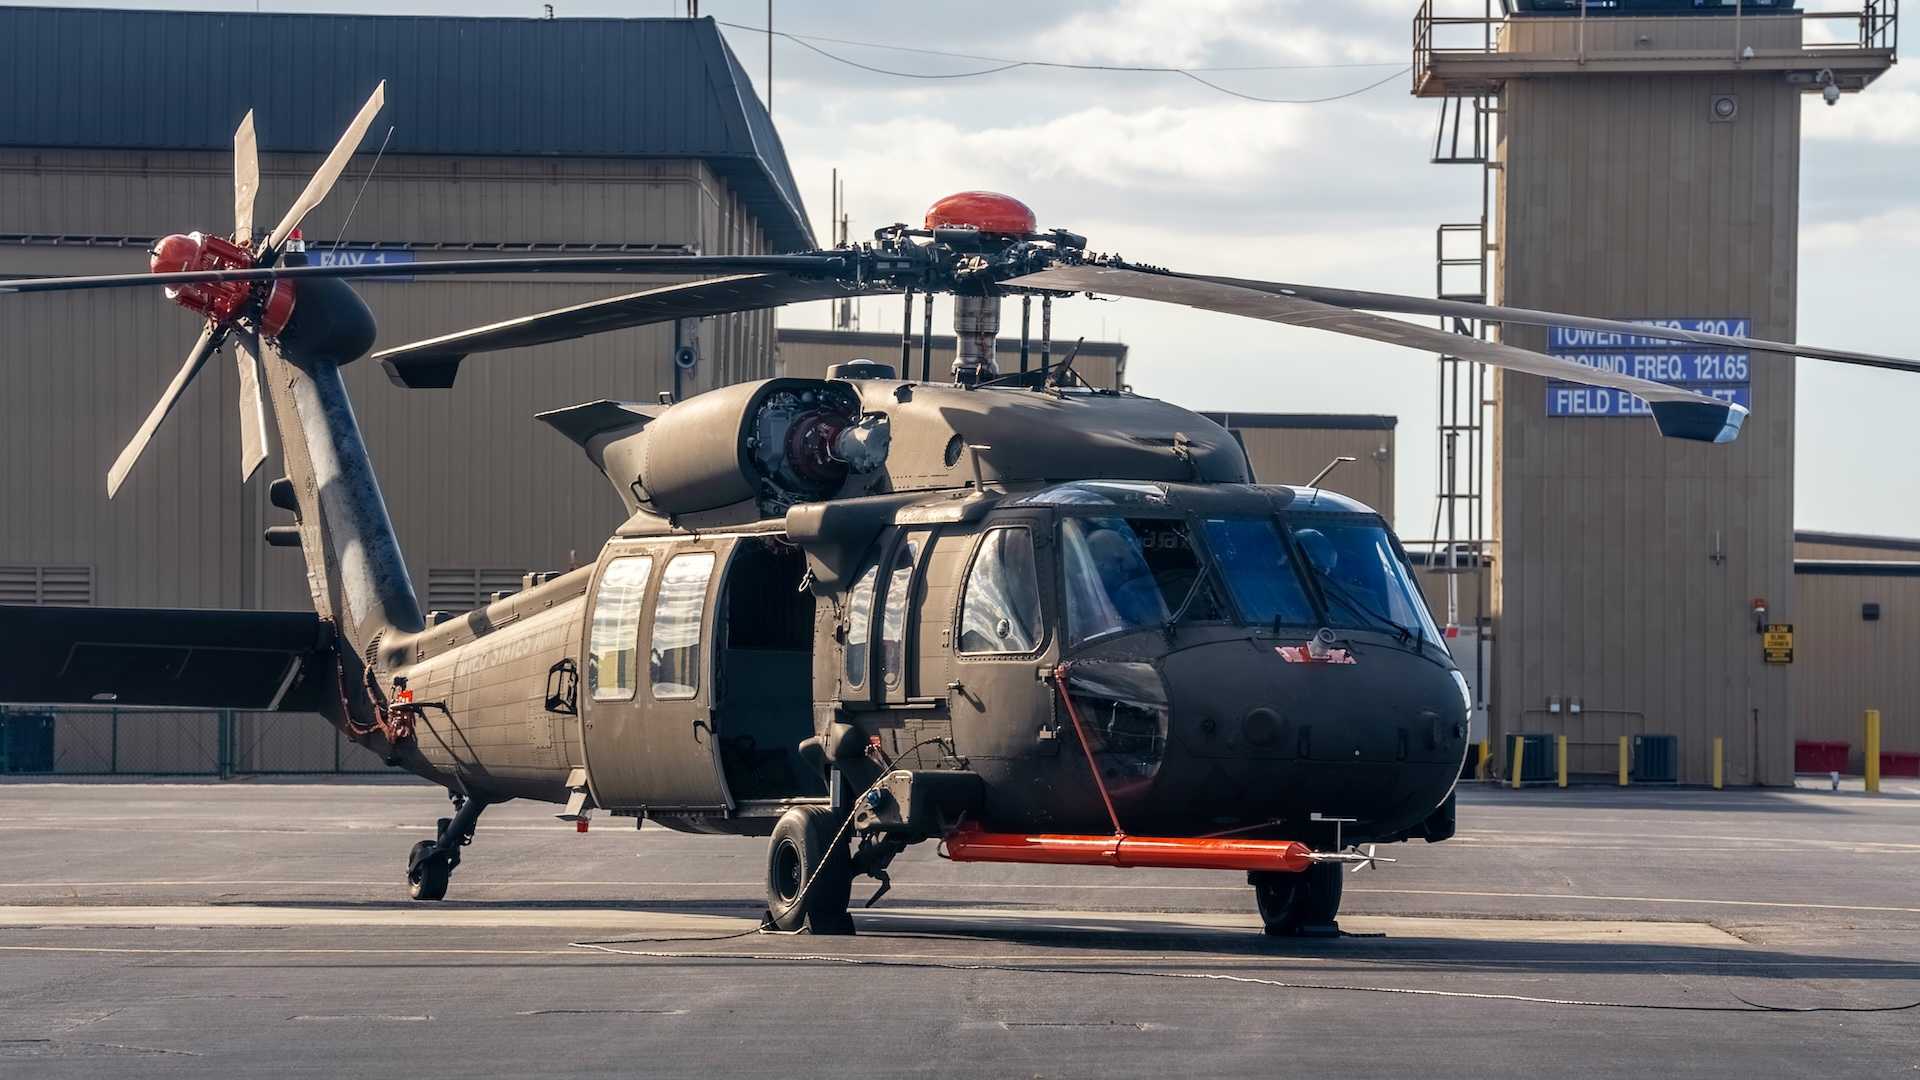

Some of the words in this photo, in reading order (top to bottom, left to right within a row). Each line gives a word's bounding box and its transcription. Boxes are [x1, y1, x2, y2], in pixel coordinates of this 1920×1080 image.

[1555, 354, 1627, 375] OUND
[1634, 355, 1687, 380] FREQ.
[1694, 355, 1748, 380] 121.65
[1557, 389, 1610, 413] FIELD
